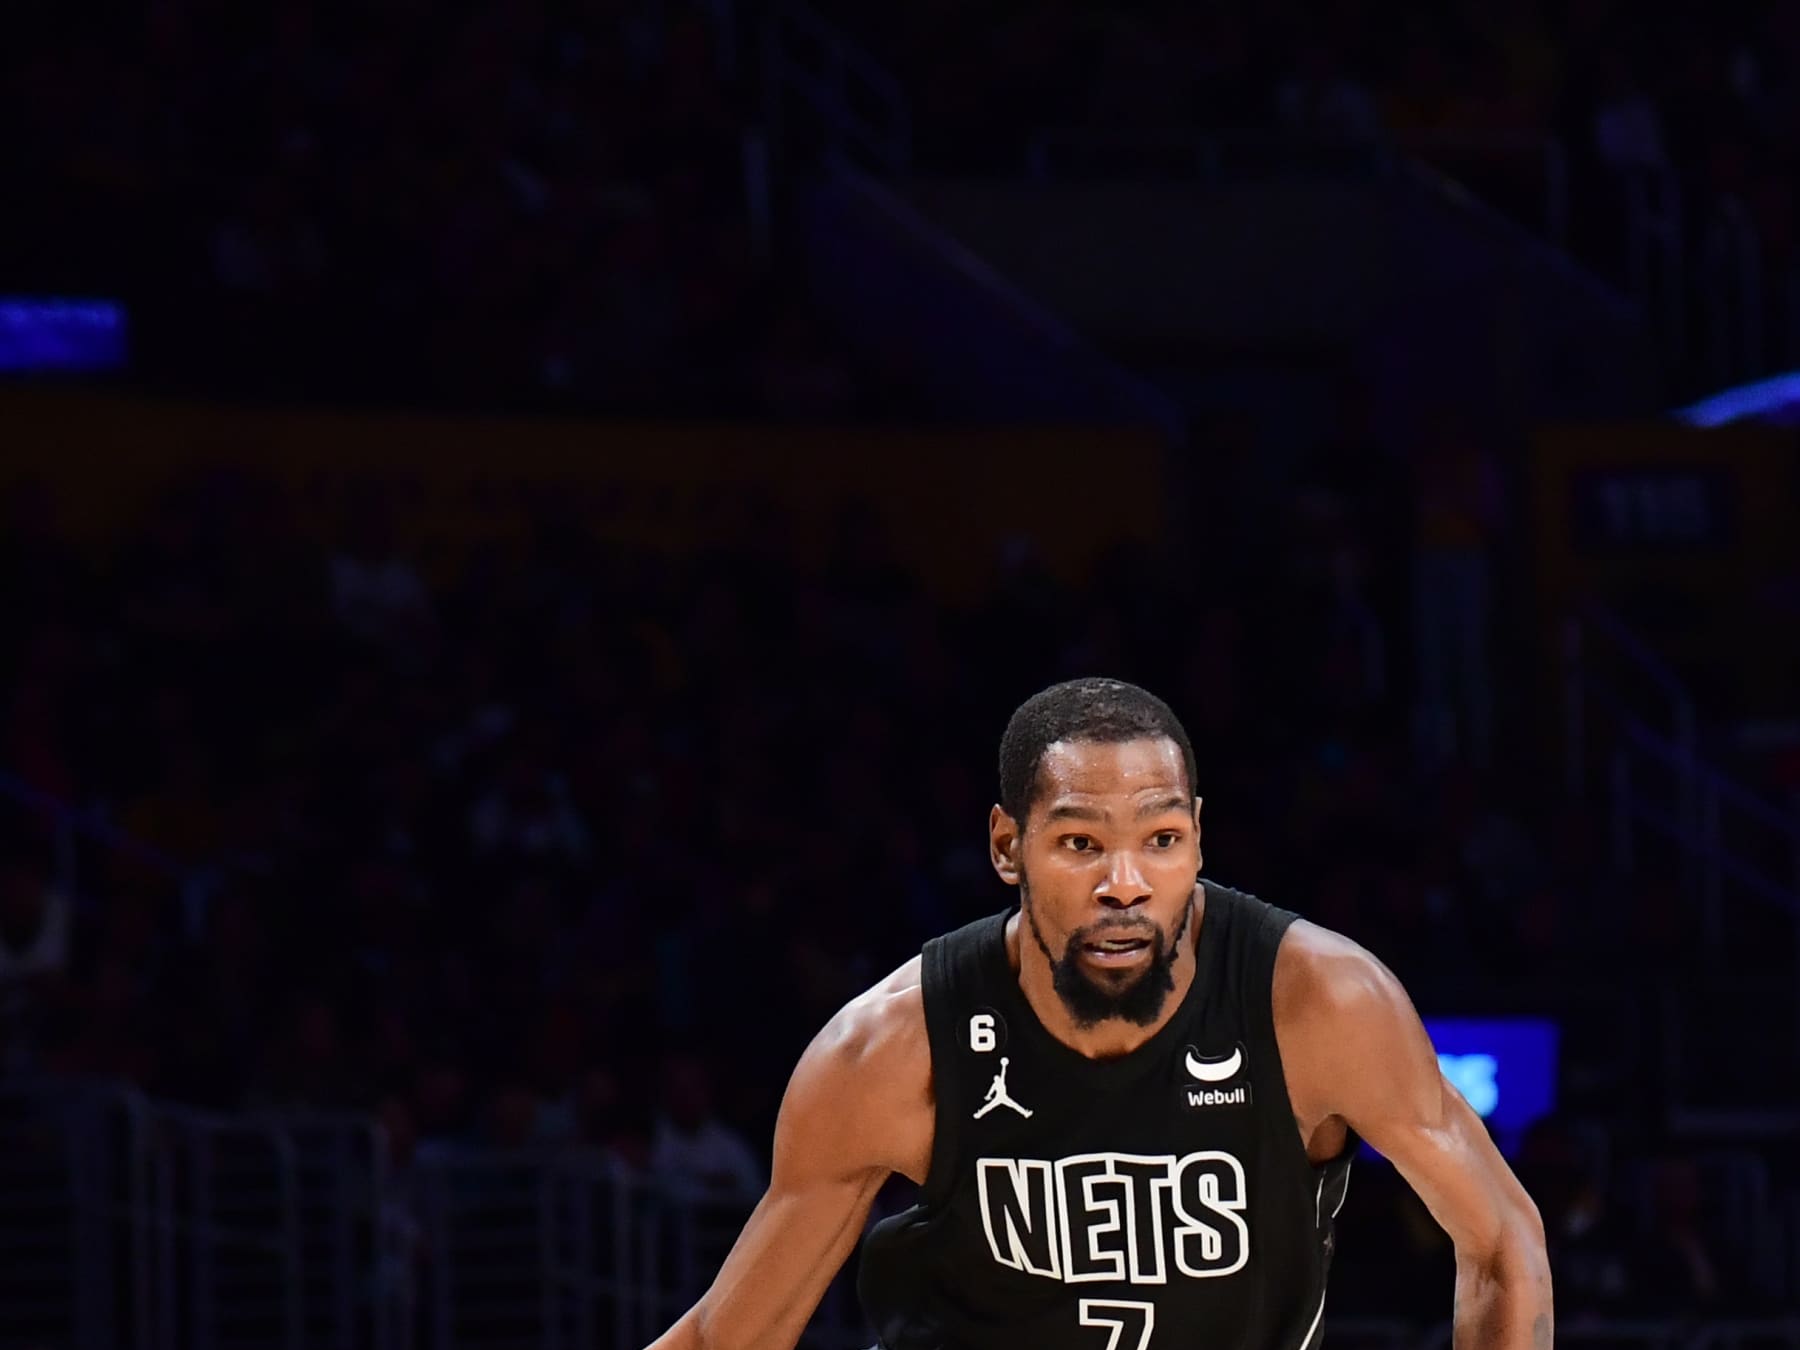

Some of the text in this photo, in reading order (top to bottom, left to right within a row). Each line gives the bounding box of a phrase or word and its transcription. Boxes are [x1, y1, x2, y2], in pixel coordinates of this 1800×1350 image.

[969, 1014, 996, 1052] 6
[1187, 1087, 1245, 1106] Webull
[976, 1150, 1249, 1284] NETS
